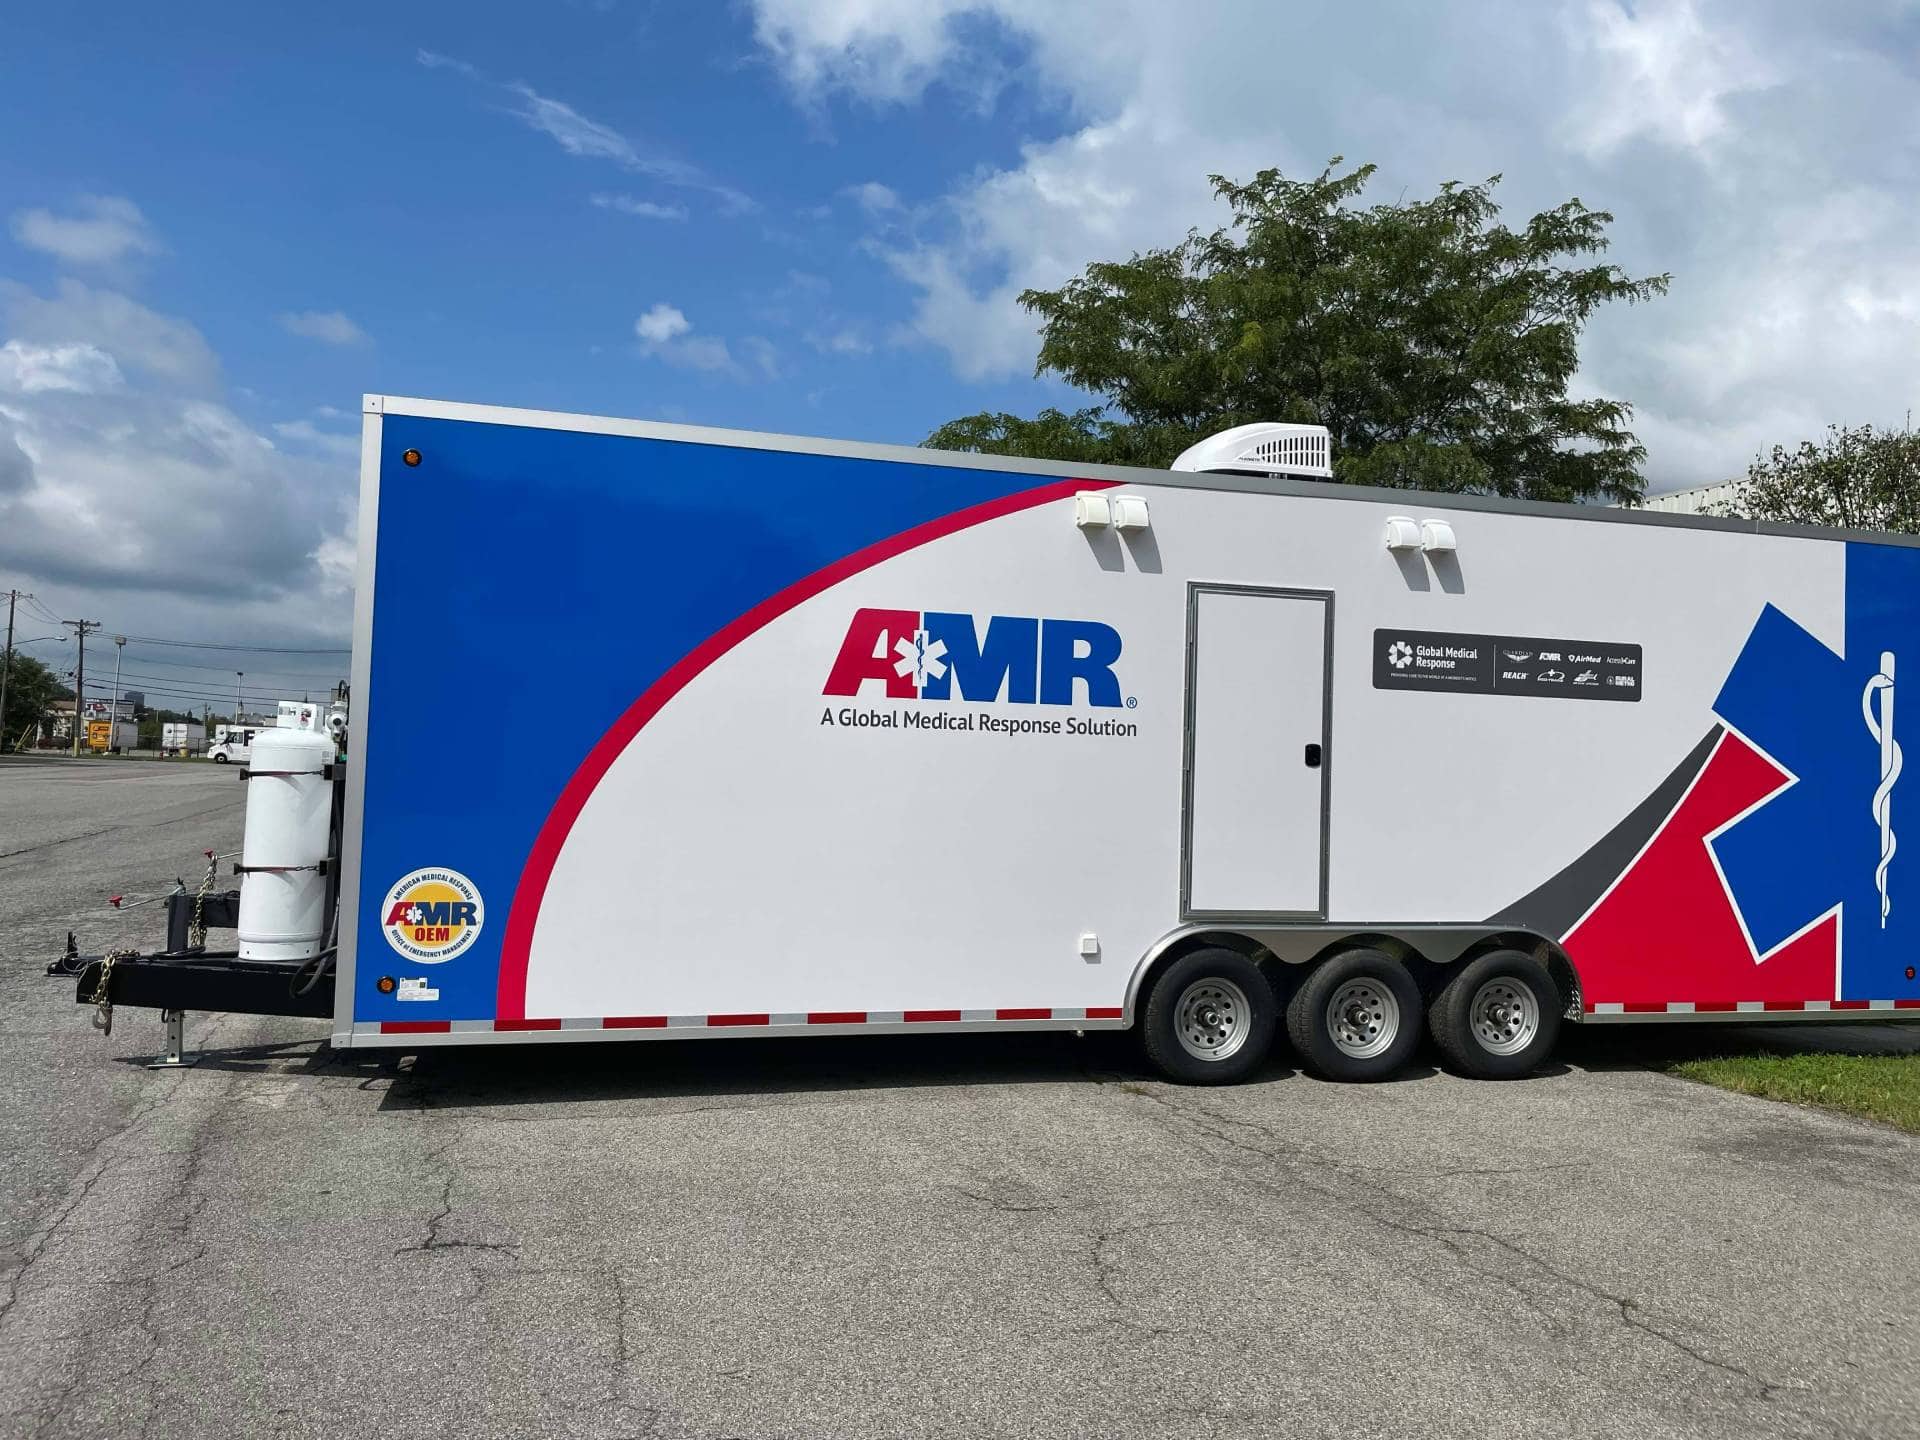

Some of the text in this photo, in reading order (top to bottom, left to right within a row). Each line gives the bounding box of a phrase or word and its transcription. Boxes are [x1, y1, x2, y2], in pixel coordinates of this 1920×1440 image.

[822, 608, 1123, 707] AMR
[1416, 646, 1477, 659] Global Medical
[1575, 655, 1602, 663] AirMed
[1416, 657, 1456, 670] Response
[1502, 671, 1527, 680] REACH
[821, 708, 1137, 736] A Global Medical Response Solution
[393, 873, 474, 900] AMERICAN MEDICAL RESPONSE
[385, 901, 477, 926] AMR
[391, 929, 405, 946] OFFICE
[409, 946, 441, 958] EMERGENCY
[442, 929, 473, 956] MANAGEMENT
[415, 927, 450, 941] OEM
